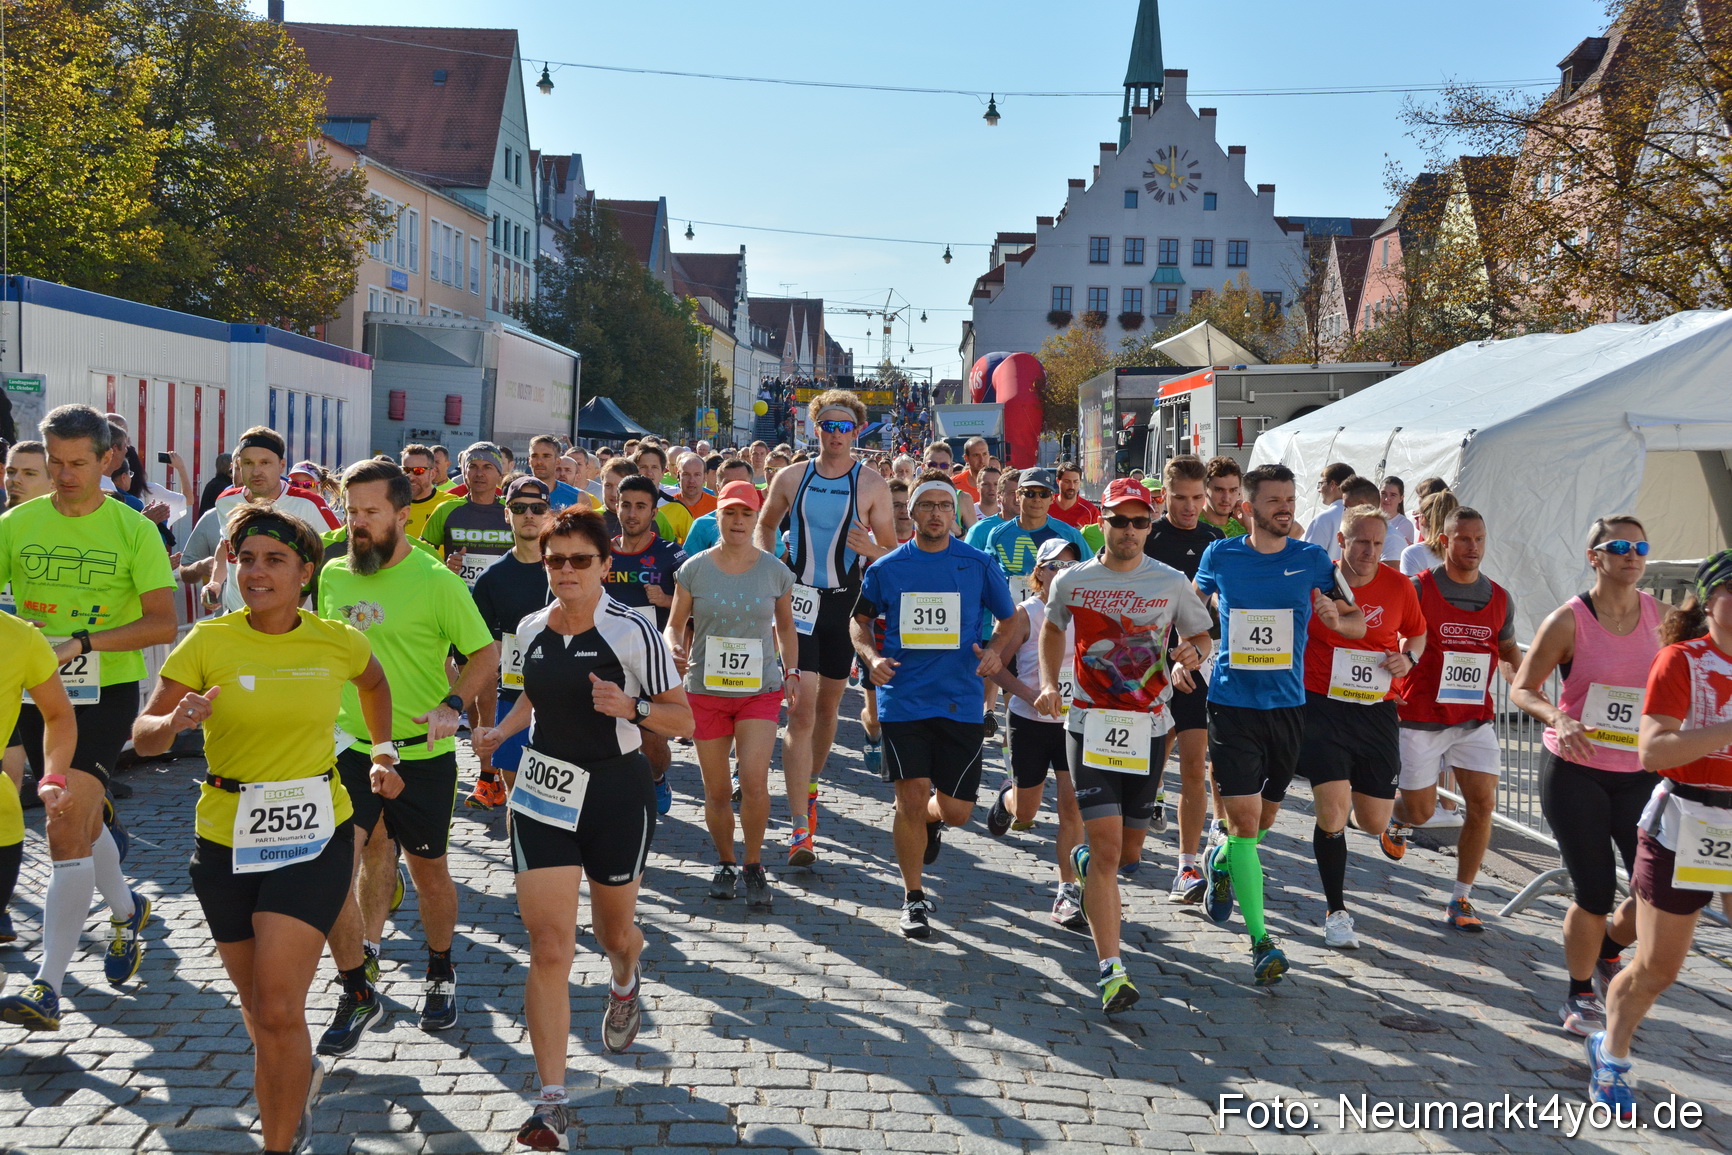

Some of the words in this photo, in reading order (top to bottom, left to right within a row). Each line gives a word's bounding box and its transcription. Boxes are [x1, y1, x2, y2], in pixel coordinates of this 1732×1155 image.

[450, 528, 514, 542] BOCK
[1071, 587, 1136, 600] FINISHER
[1083, 597, 1129, 610] RELAY
[1131, 597, 1169, 609] TEAM
[913, 608, 947, 625] 319
[1100, 607, 1123, 615] ROTH
[1249, 626, 1273, 645] 43
[1464, 627, 1489, 637] STREET
[722, 642, 747, 650] BOCK
[719, 652, 750, 670] 157
[1247, 655, 1274, 663] Florian
[1351, 654, 1377, 663] BOCK
[516, 676, 524, 684] St
[1351, 665, 1373, 683] 96
[1445, 666, 1481, 683] 3060
[722, 678, 744, 686] Maren
[68, 689, 79, 697] as
[1343, 690, 1375, 700] Christian
[1607, 689, 1639, 700] BOCK
[1606, 702, 1633, 723] 95
[1105, 715, 1134, 724] BOCK
[1105, 728, 1130, 748] 42
[1596, 730, 1634, 745] Manuela
[1108, 757, 1123, 766] Tim
[525, 756, 575, 794] 3062
[264, 787, 304, 800] BOCK
[249, 803, 319, 834] 2552
[277, 834, 306, 842] Neumarkt
[260, 846, 308, 861] Cornelia
[1698, 838, 1732, 859] 32
